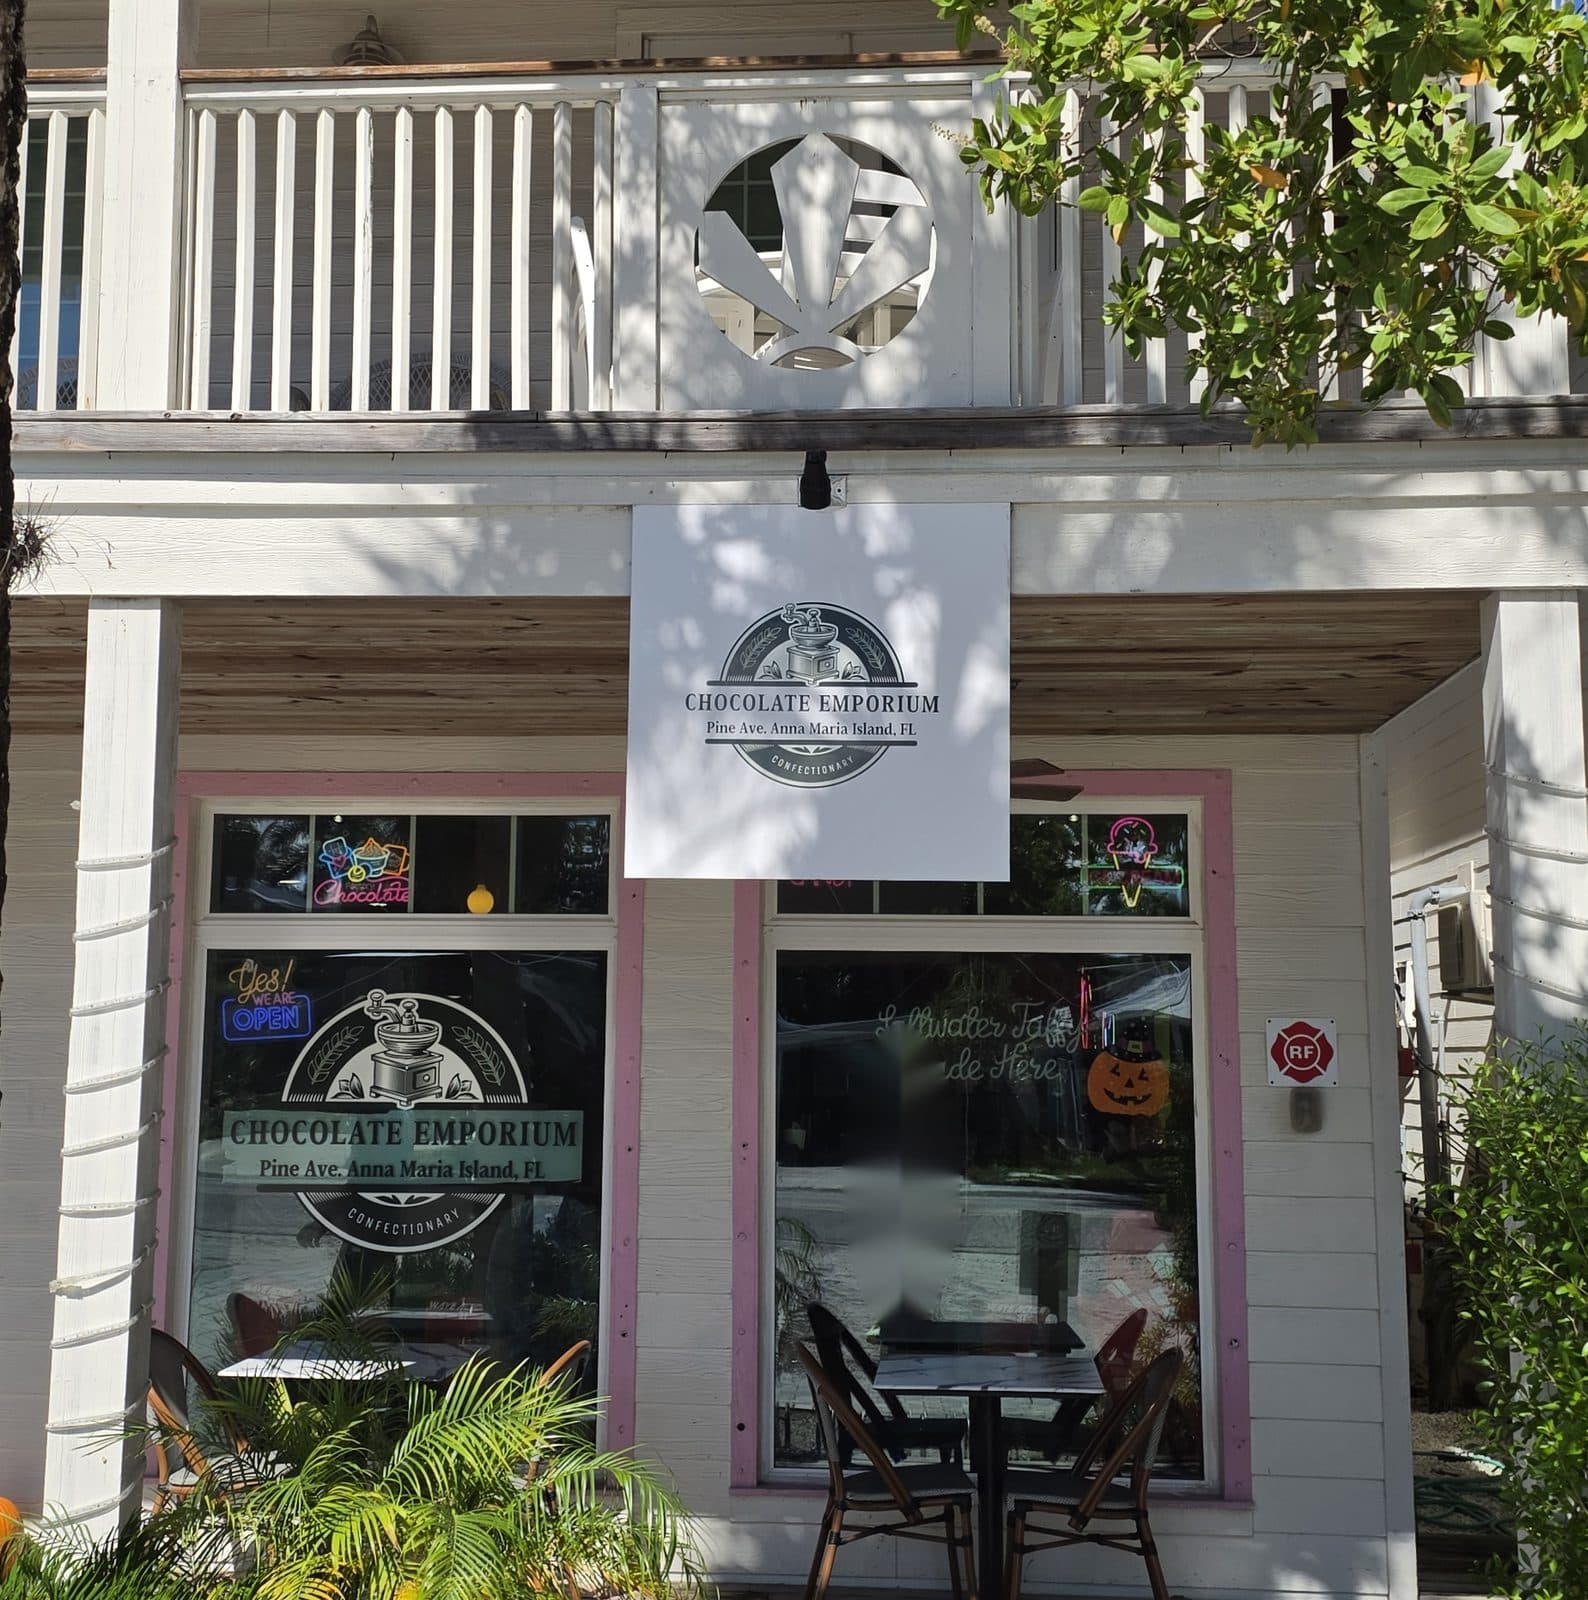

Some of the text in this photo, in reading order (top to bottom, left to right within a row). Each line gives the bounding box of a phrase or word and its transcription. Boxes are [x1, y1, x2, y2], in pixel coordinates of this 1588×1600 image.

[685, 693, 939, 713] CHOCOLATE EMPORIUM
[706, 721, 917, 737] Pine Ave. Anna Maria Island, FL
[771, 754, 854, 776] CONFECTIONARY
[313, 877, 409, 905] Chocolate
[228, 958, 294, 1004] Yes!
[252, 991, 296, 1006] WE ARE
[232, 1005, 299, 1032] OPEN
[990, 1043, 1062, 1081] Here
[1289, 1045, 1315, 1059] RF
[230, 1119, 577, 1147] CHOCOLATE EMPORIUM
[259, 1158, 546, 1182] Pine Ave. Anna Maria Island, FL
[347, 1207, 461, 1236] CONFECTIONARY
